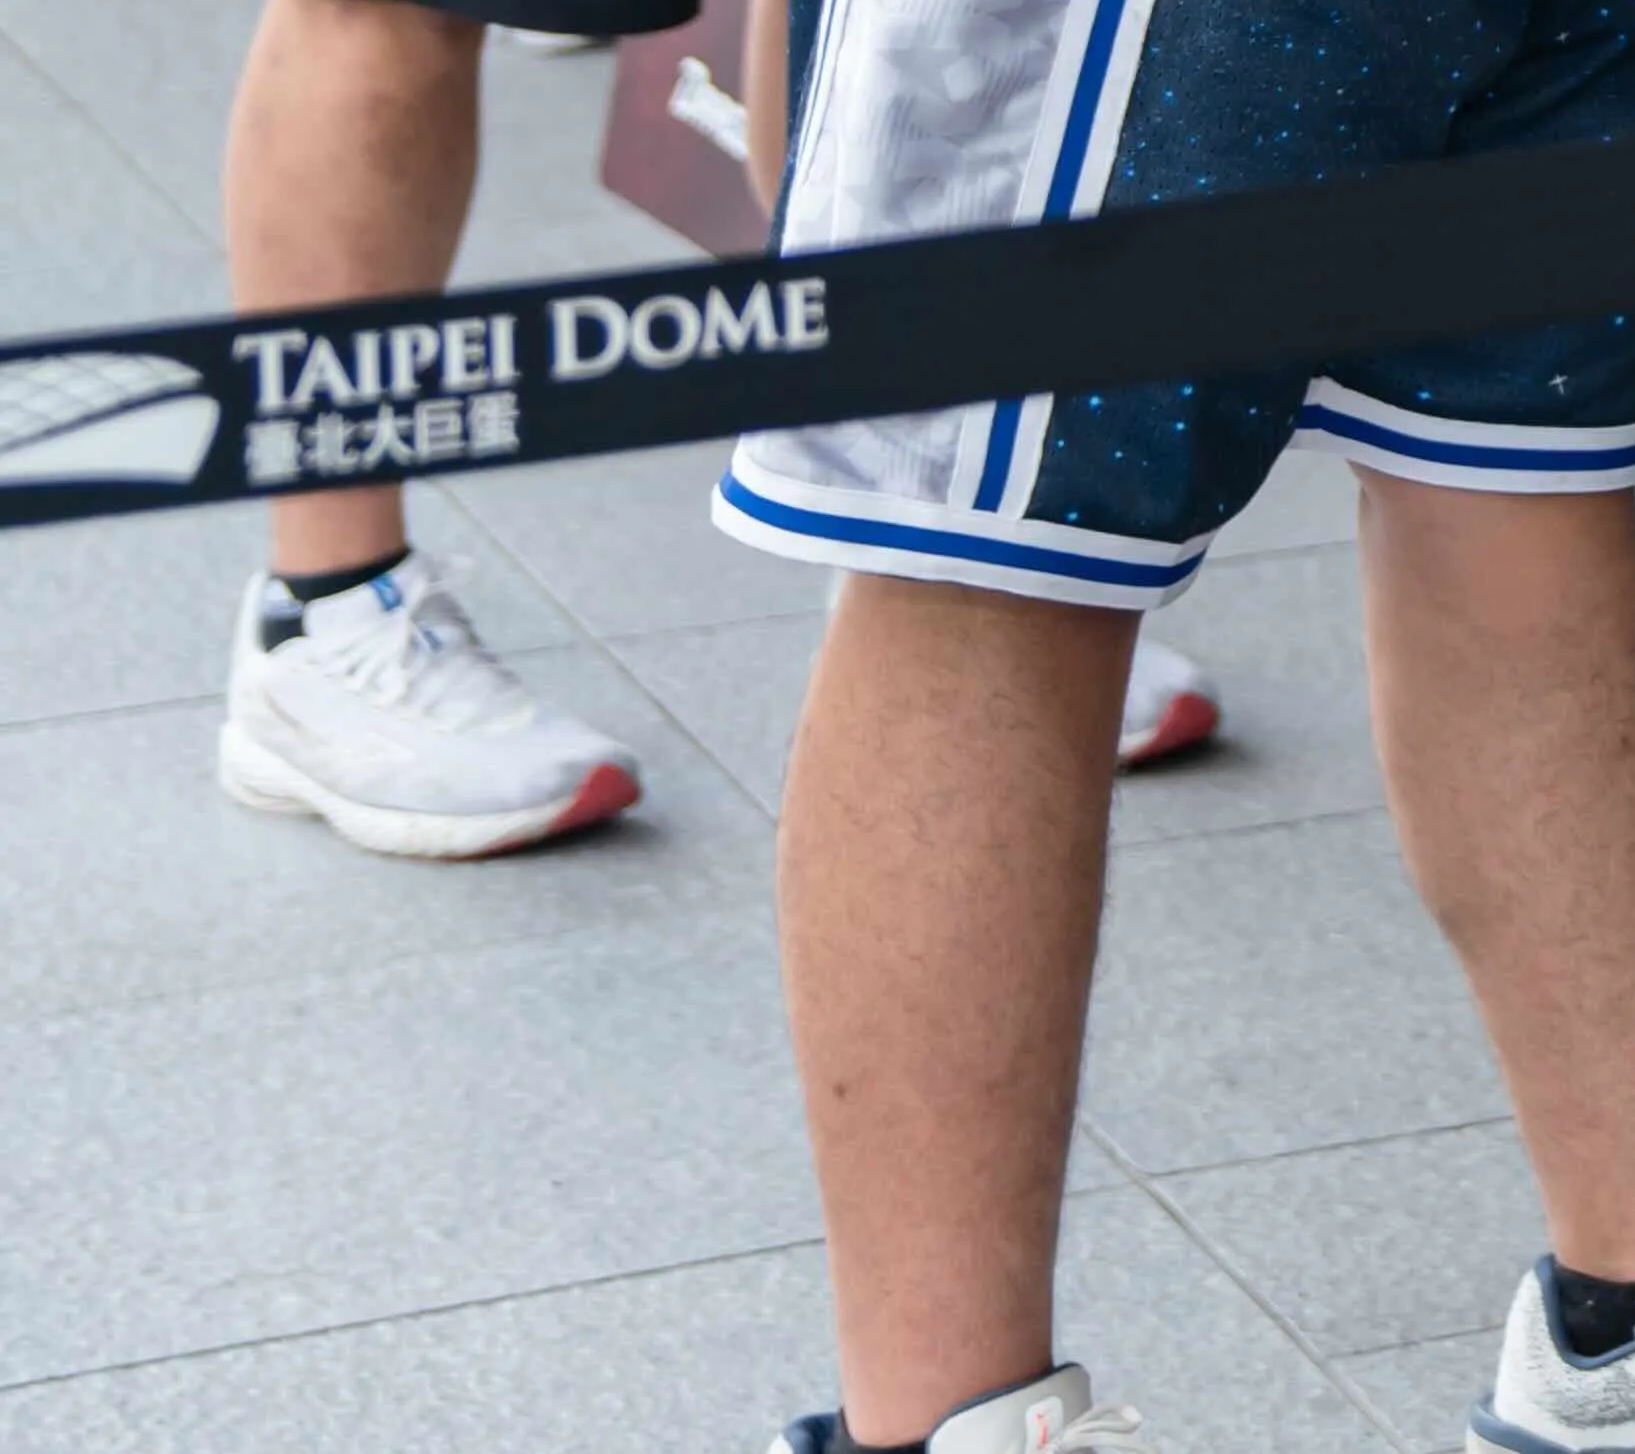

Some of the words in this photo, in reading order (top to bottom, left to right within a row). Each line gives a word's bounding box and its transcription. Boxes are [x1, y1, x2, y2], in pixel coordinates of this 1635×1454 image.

[232, 312, 520, 415] TAIPEI
[548, 277, 829, 382] DOME
[244, 390, 520, 488] 臺北大巨蛋
